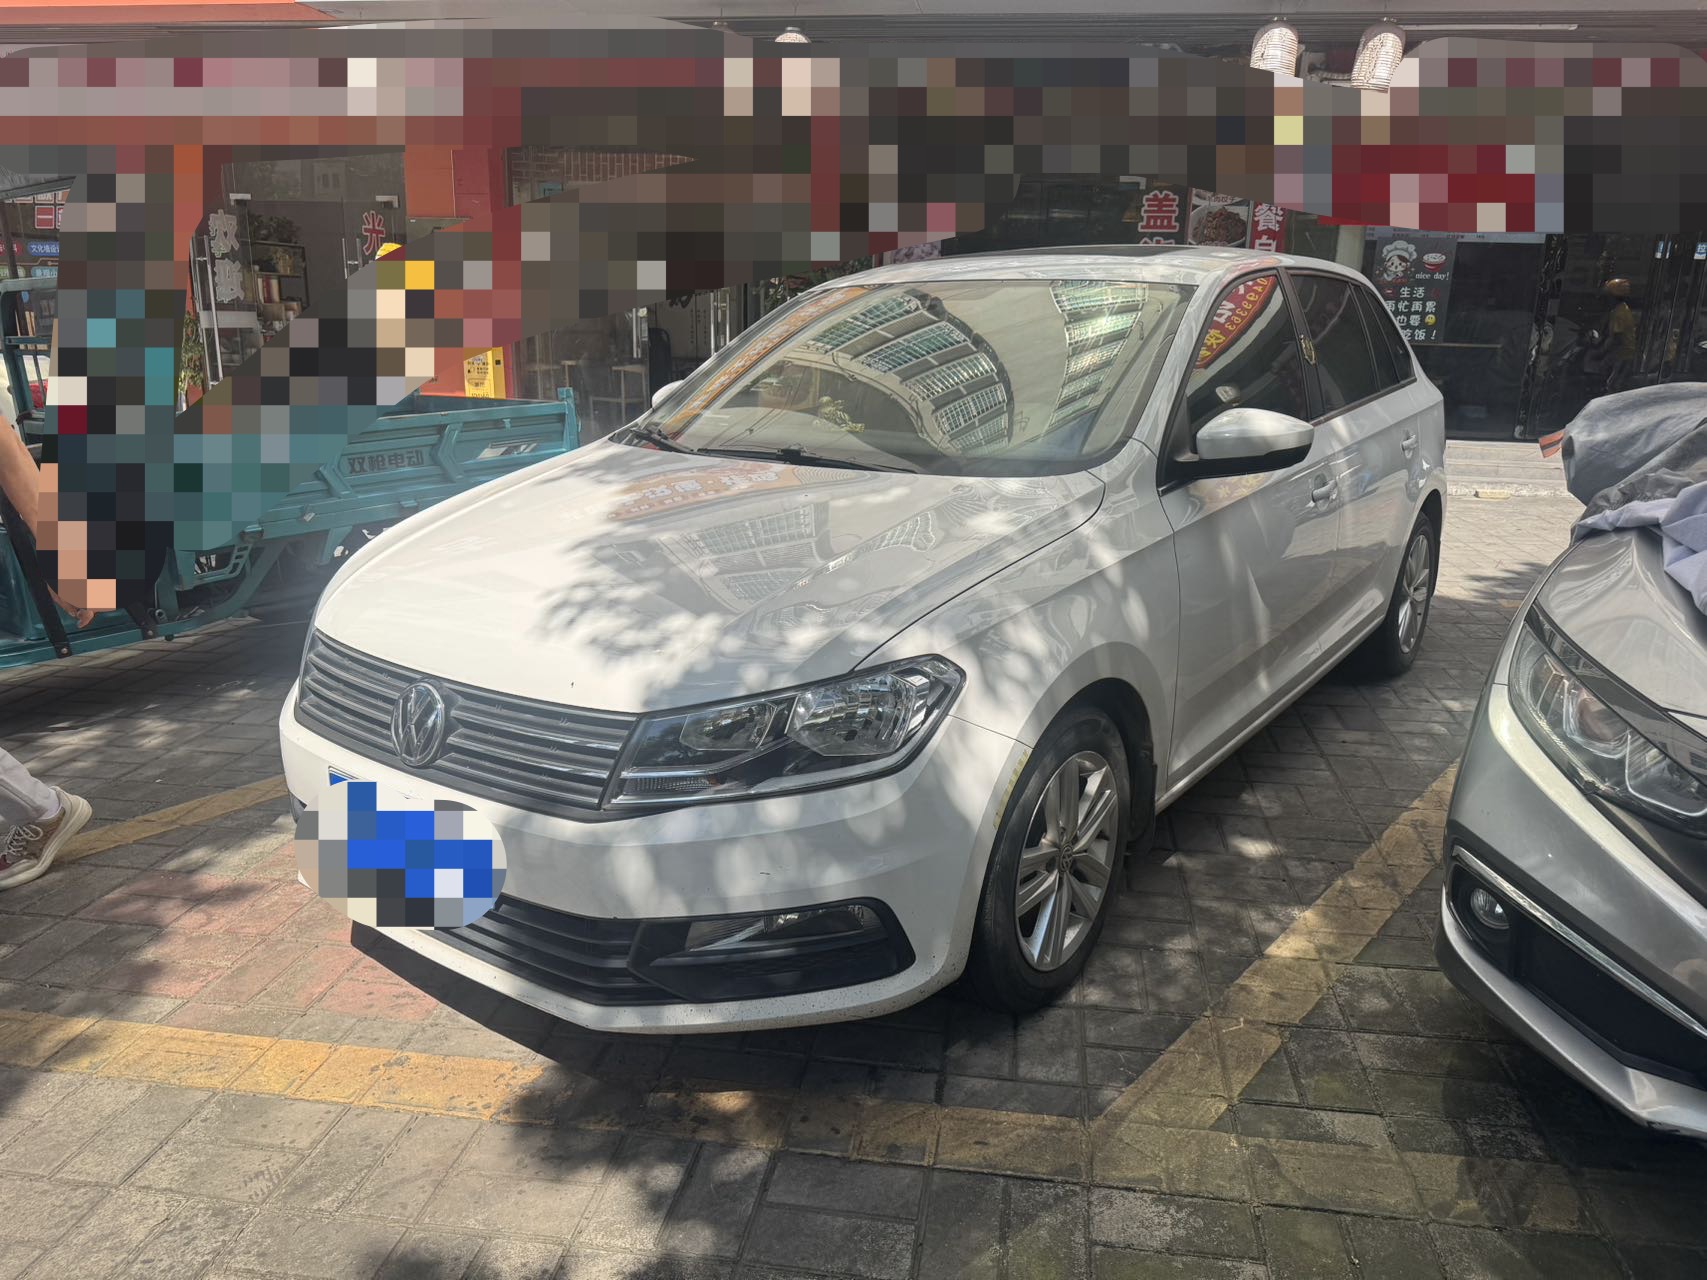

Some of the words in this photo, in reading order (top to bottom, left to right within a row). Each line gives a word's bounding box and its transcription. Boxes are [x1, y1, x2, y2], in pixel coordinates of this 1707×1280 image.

[1415, 272, 1431, 280] nice
[1433, 272, 1450, 281] day!
[1400, 287, 1425, 298] 生活
[1396, 315, 1421, 326] 也要
[347, 449, 425, 475] 双枪电动
